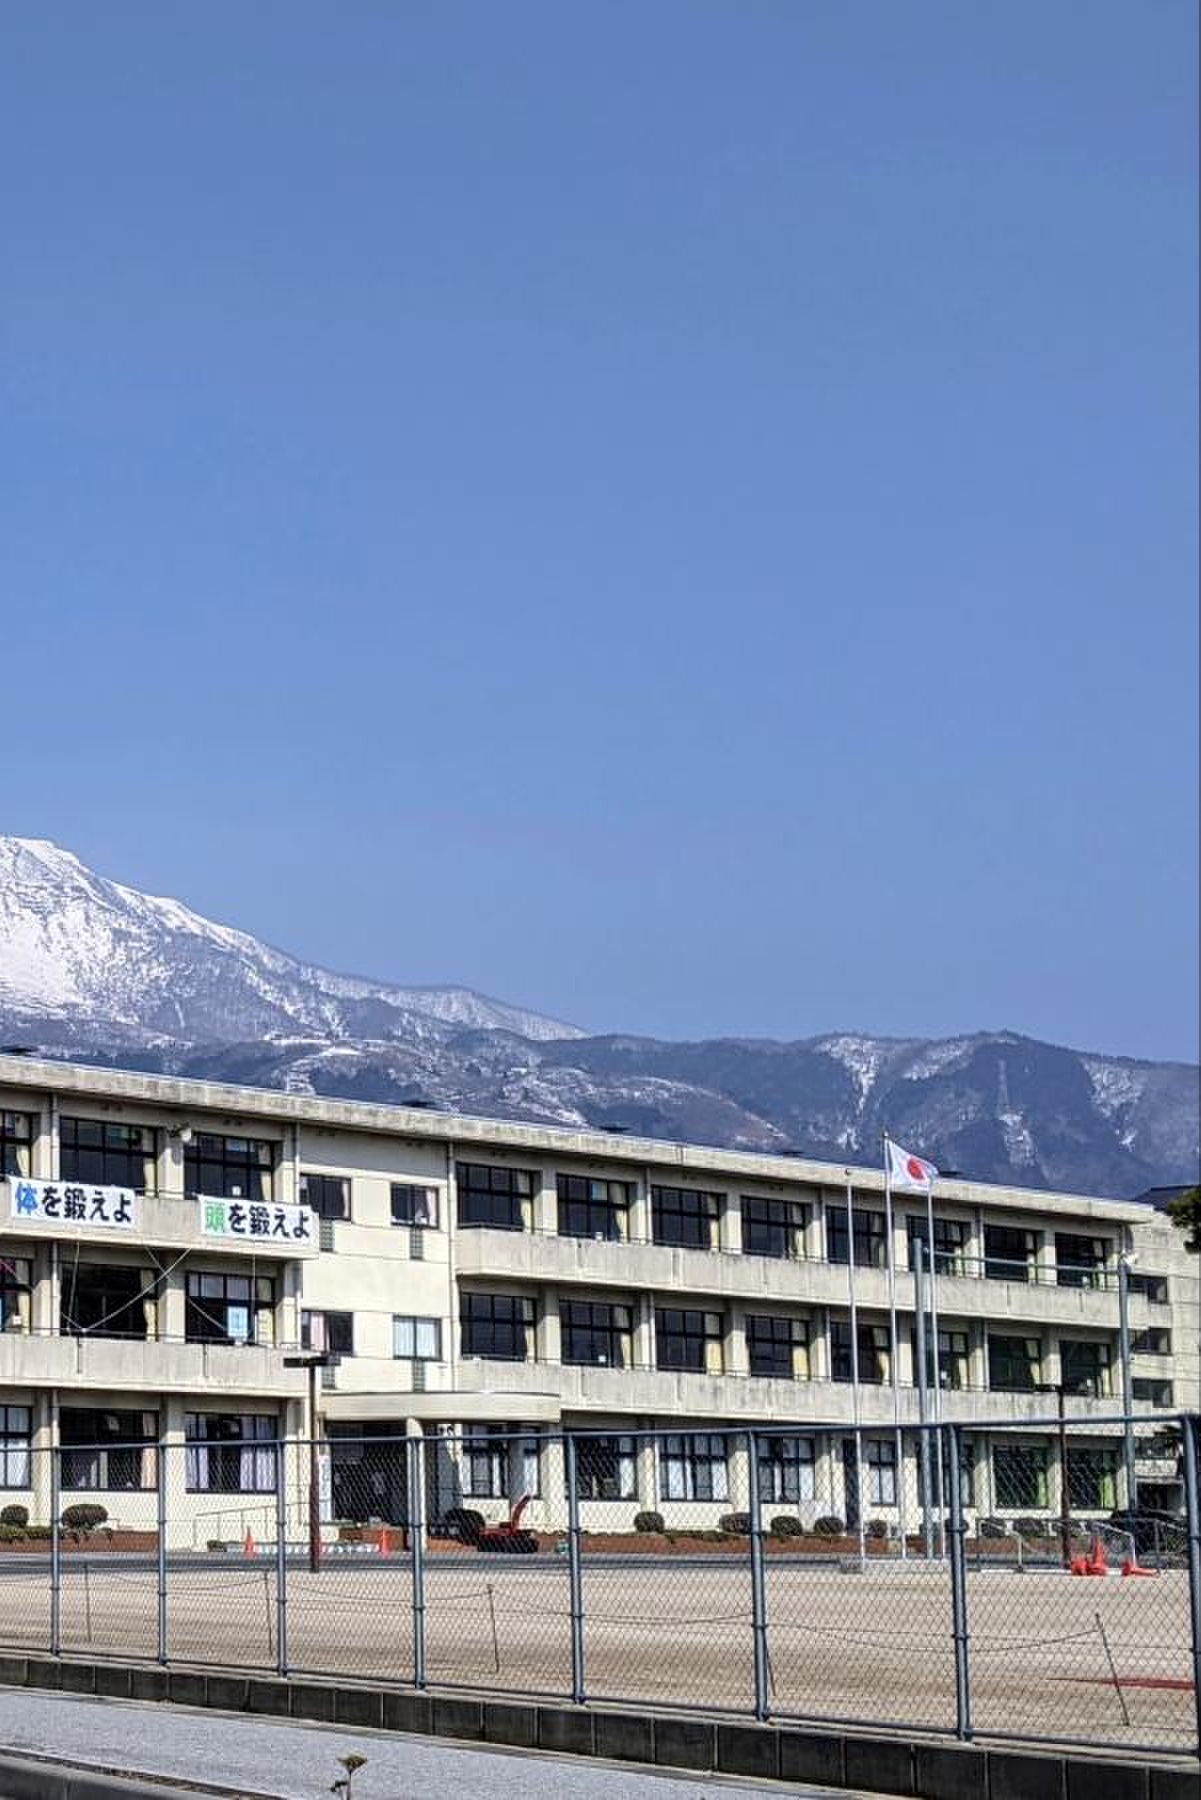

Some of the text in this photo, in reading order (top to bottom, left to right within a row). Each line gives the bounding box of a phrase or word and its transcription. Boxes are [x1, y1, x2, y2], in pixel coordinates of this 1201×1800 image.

[15, 1182, 132, 1222] 体を鍛えよ
[205, 1201, 310, 1239] 頭を鍛えよ
